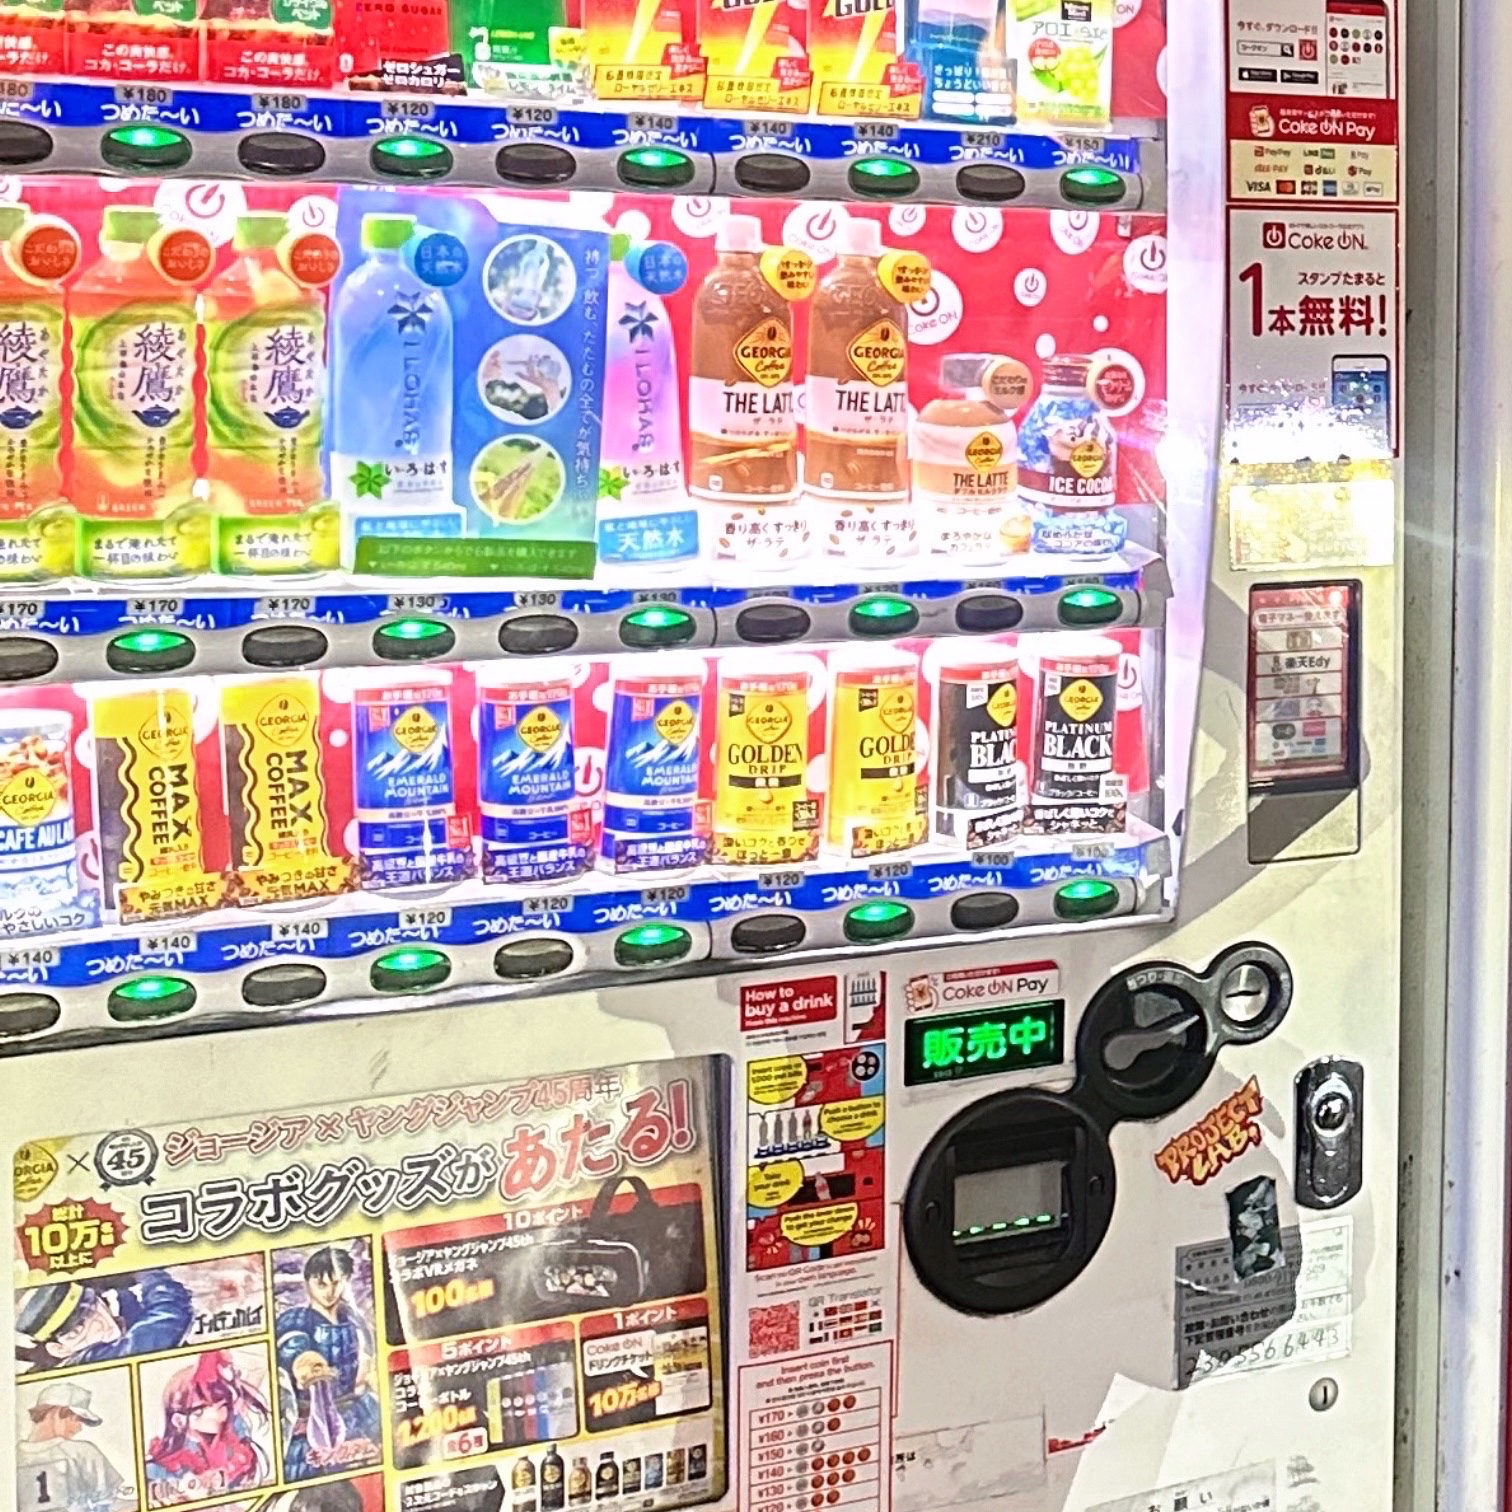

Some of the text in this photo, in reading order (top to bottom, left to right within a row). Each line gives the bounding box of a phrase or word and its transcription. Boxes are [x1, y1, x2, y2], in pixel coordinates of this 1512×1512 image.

[122, 87, 167, 103] ¥180
[258, 96, 301, 110] ¥180
[1279, 119, 1376, 142] Coke ON Pay
[1246, 181, 1271, 192] VISA
[1288, 230, 1365, 250] Coke ON
[1297, 271, 1386, 286] スタンプたまると
[1238, 262, 1387, 338] 1本無料!
[131, 323, 177, 404] 綾鷹
[263, 325, 306, 405] 綾鷹
[953, 472, 1009, 488] THE LATTE
[1049, 476, 1074, 492] ICE
[617, 529, 686, 552] 天然水
[134, 599, 179, 614] ¥170
[268, 598, 312, 612] ¥170
[1284, 655, 1331, 671] 楽天Edy
[258, 713, 310, 727] GEORGIA
[1045, 721, 1113, 736] PLATINUM
[1043, 733, 1113, 758] BLACK
[970, 743, 1016, 768] BLAC
[748, 763, 788, 775] DRIP
[387, 773, 447, 788] EMERALD
[511, 771, 570, 786] EMERALD
[265, 751, 288, 831] COFFEE
[284, 749, 314, 831] MAX
[384, 785, 450, 799] MOUNTAIN
[508, 781, 572, 797] MOUNTAIN
[148, 765, 171, 844] COFFEE
[167, 762, 193, 839] MAX
[528, 897, 569, 911] ¥120
[404, 911, 446, 926] ¥120
[147, 934, 191, 950] ¥140
[8, 950, 54, 965] ¥140
[744, 986, 795, 1003] How to
[942, 977, 1049, 1001] Coke ON Pay
[744, 992, 834, 1018] buy a drink
[922, 1015, 1047, 1069] 販売中
[1154, 1074, 1263, 1184] PROJECT
[106, 1152, 146, 1171] 45
[141, 1078, 694, 1243] コラボグッズがあたる!
[503, 1204, 584, 1232] 10ポイント
[50, 1250, 94, 1269] 以上に
[613, 1304, 678, 1331] 1ポイント
[440, 1334, 513, 1361] 5ポイント
[757, 1448, 785, 1462] ¥150
[757, 1484, 785, 1498] ¥130
